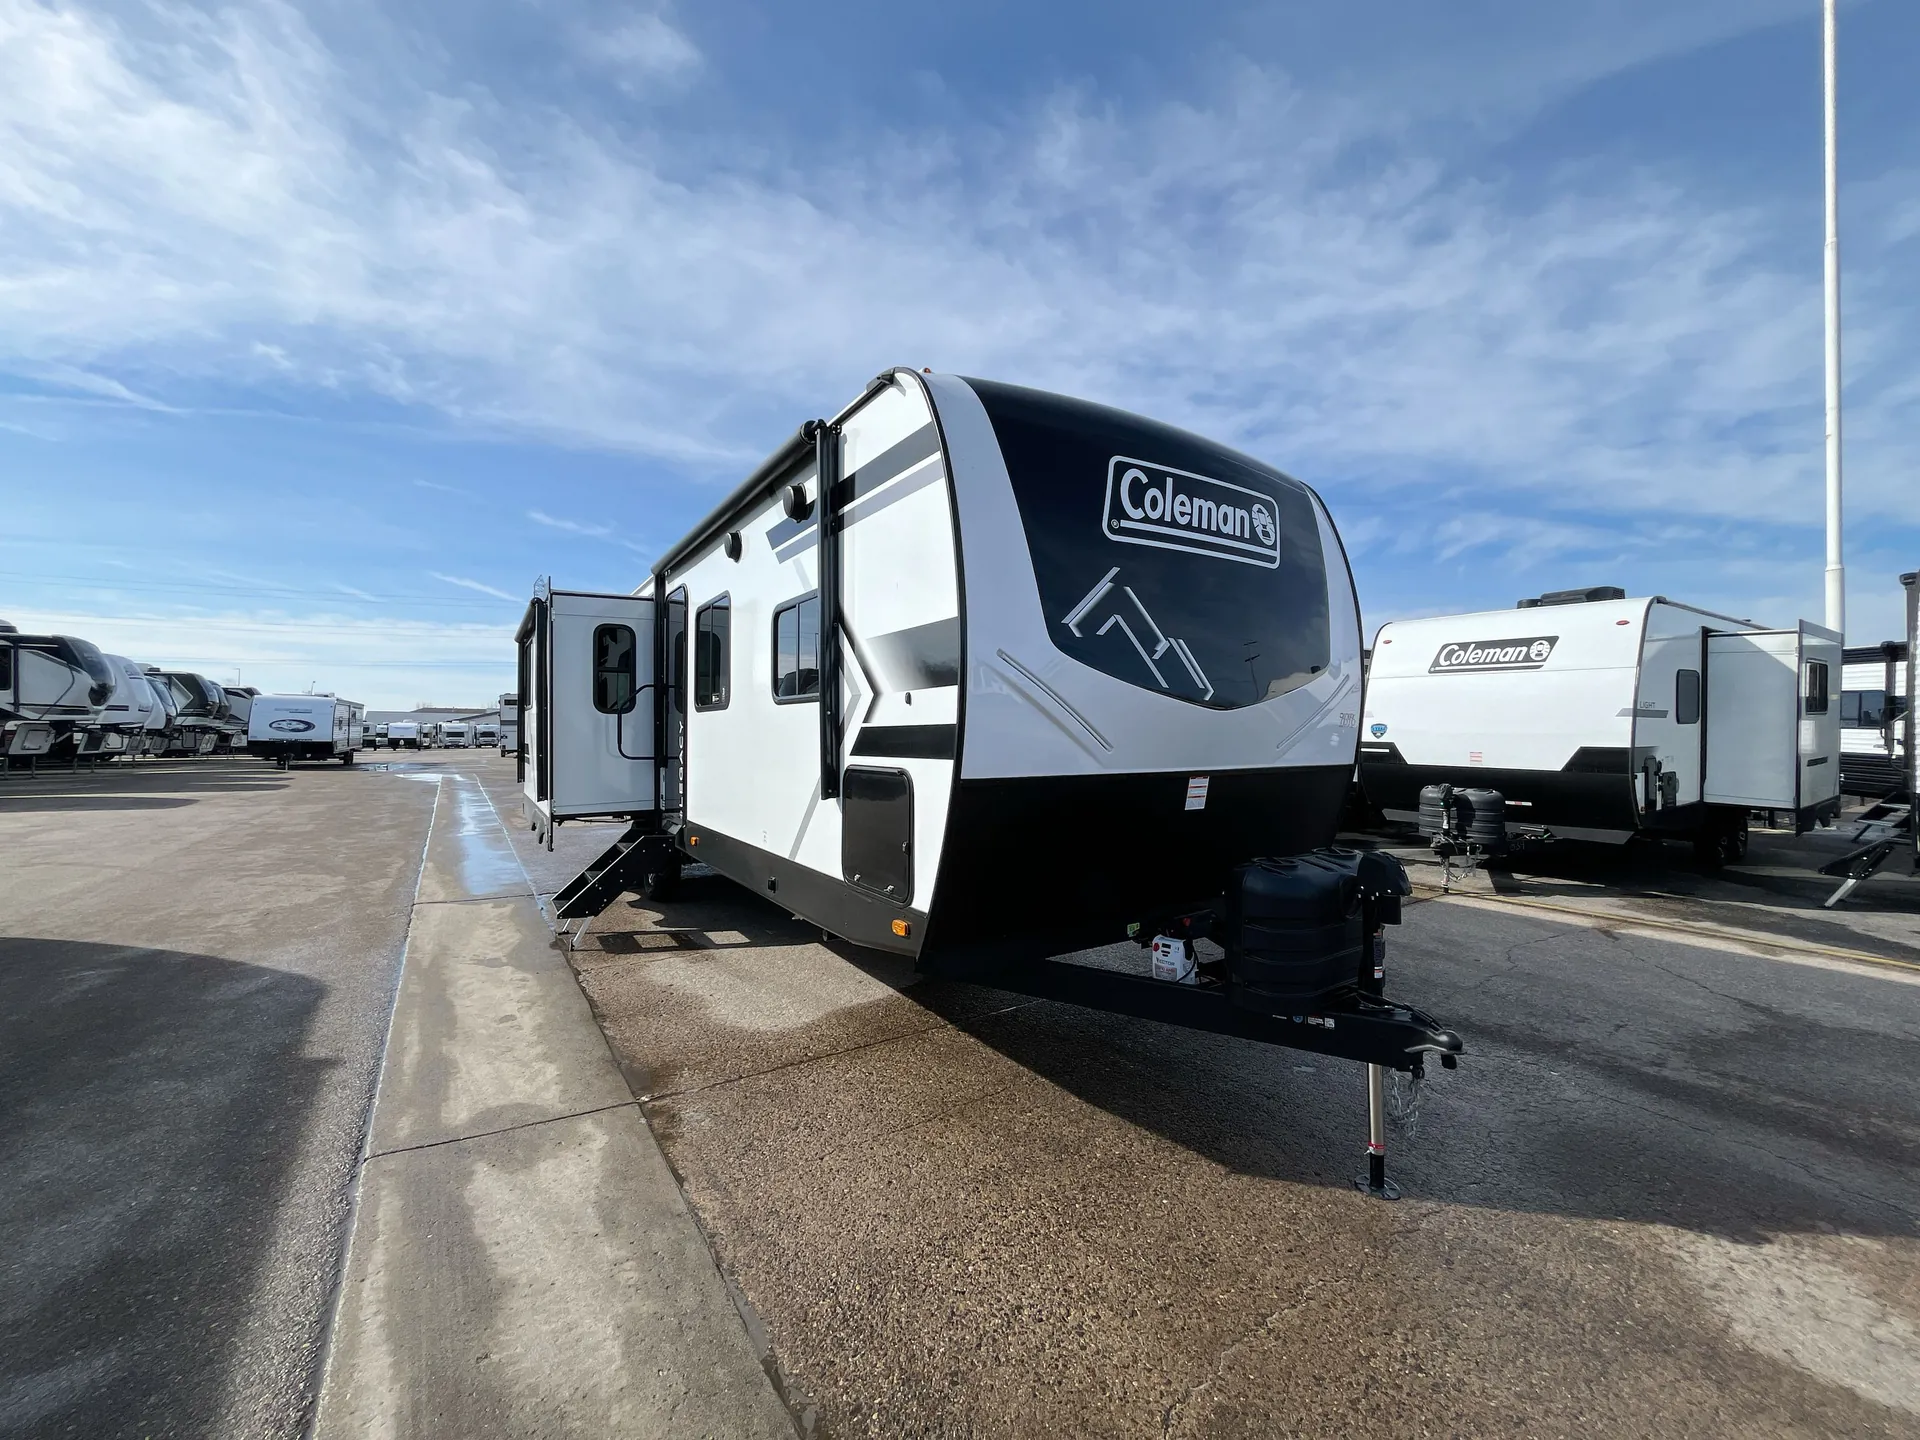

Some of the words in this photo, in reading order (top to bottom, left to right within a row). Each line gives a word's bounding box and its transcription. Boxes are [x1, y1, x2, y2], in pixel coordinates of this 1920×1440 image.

[1120, 468, 1250, 538] Coleman
[1439, 645, 1528, 666] Coleman
[1639, 700, 1656, 709] LIGHT
